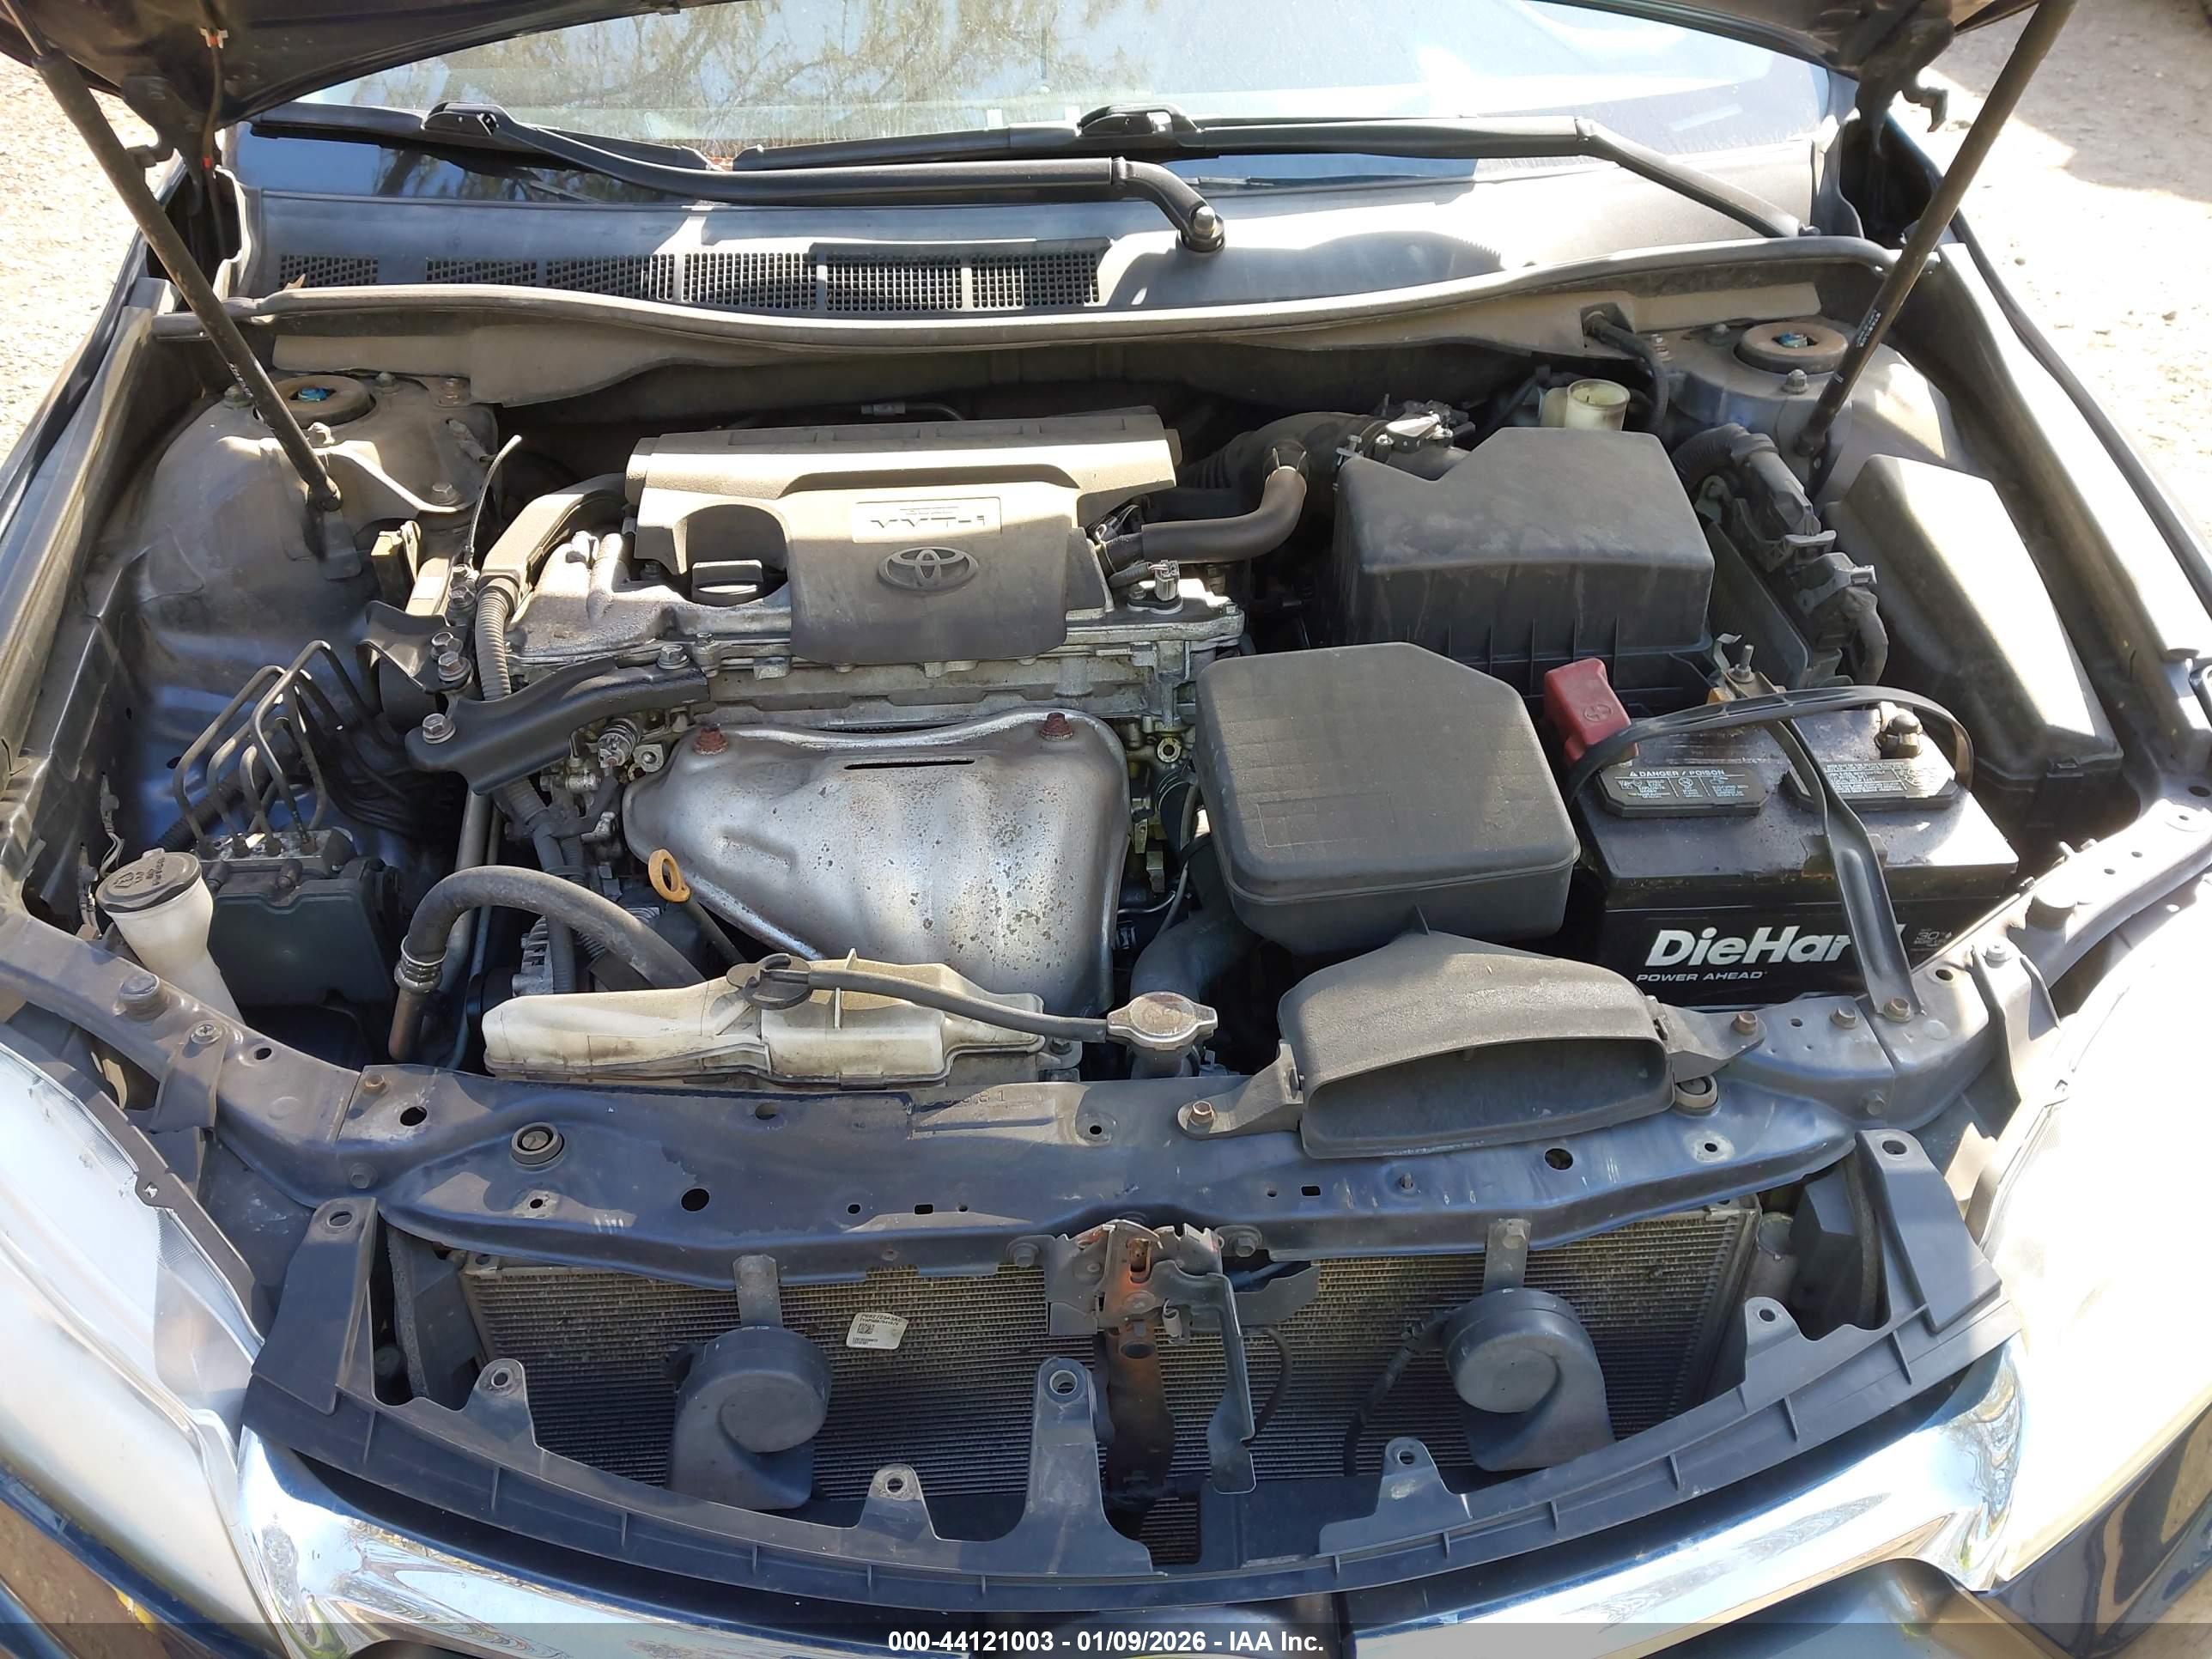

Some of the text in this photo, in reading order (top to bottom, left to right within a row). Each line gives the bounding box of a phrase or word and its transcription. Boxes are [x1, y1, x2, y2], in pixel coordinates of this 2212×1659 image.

[1645, 925, 1905, 967] DieHar
[1636, 971, 1764, 982] POWER AHEAD
